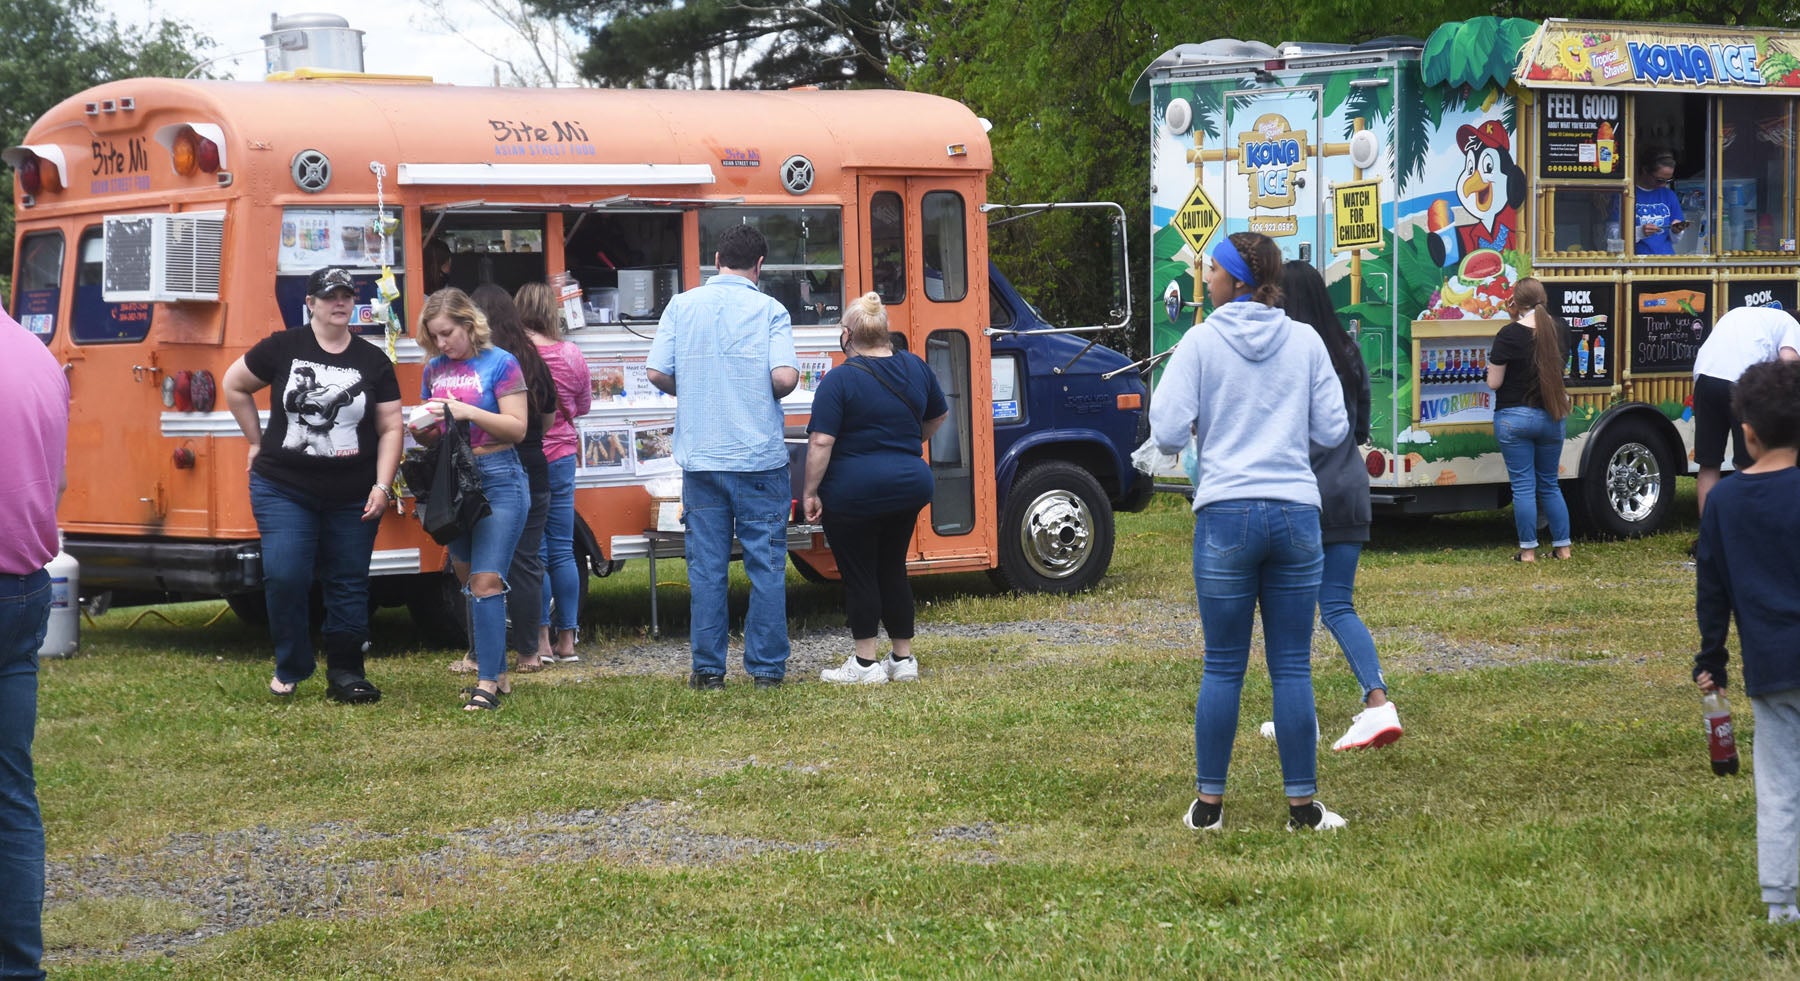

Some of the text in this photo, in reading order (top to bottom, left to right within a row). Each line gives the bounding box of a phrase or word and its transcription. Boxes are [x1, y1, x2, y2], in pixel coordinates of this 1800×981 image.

[1590, 48, 1619, 69] Tropical
[1627, 41, 1762, 85] KONA ICE
[1603, 60, 1629, 80] Shaved
[1547, 94, 1618, 120] FEEL GOOD
[487, 118, 589, 142] Bite Mi
[1486, 124, 1494, 134] K
[91, 136, 148, 176] Bite Mi
[495, 143, 596, 156] ASIAN STREET FOOD
[1246, 139, 1299, 169] KONA
[1257, 168, 1288, 197] ICE
[1343, 191, 1370, 208] WATCH
[1182, 210, 1214, 230] CAUTION
[1350, 208, 1364, 224] FOR
[1340, 223, 1376, 241] CHILDREN
[1564, 291, 1591, 304] PICK
[1745, 290, 1773, 307] BOOK
[1561, 305, 1580, 313] YOUR
[1643, 316, 1690, 332] Thank you
[1648, 332, 1658, 342] for
[1639, 340, 1669, 363] Social
[337, 447, 360, 457] FAITH
